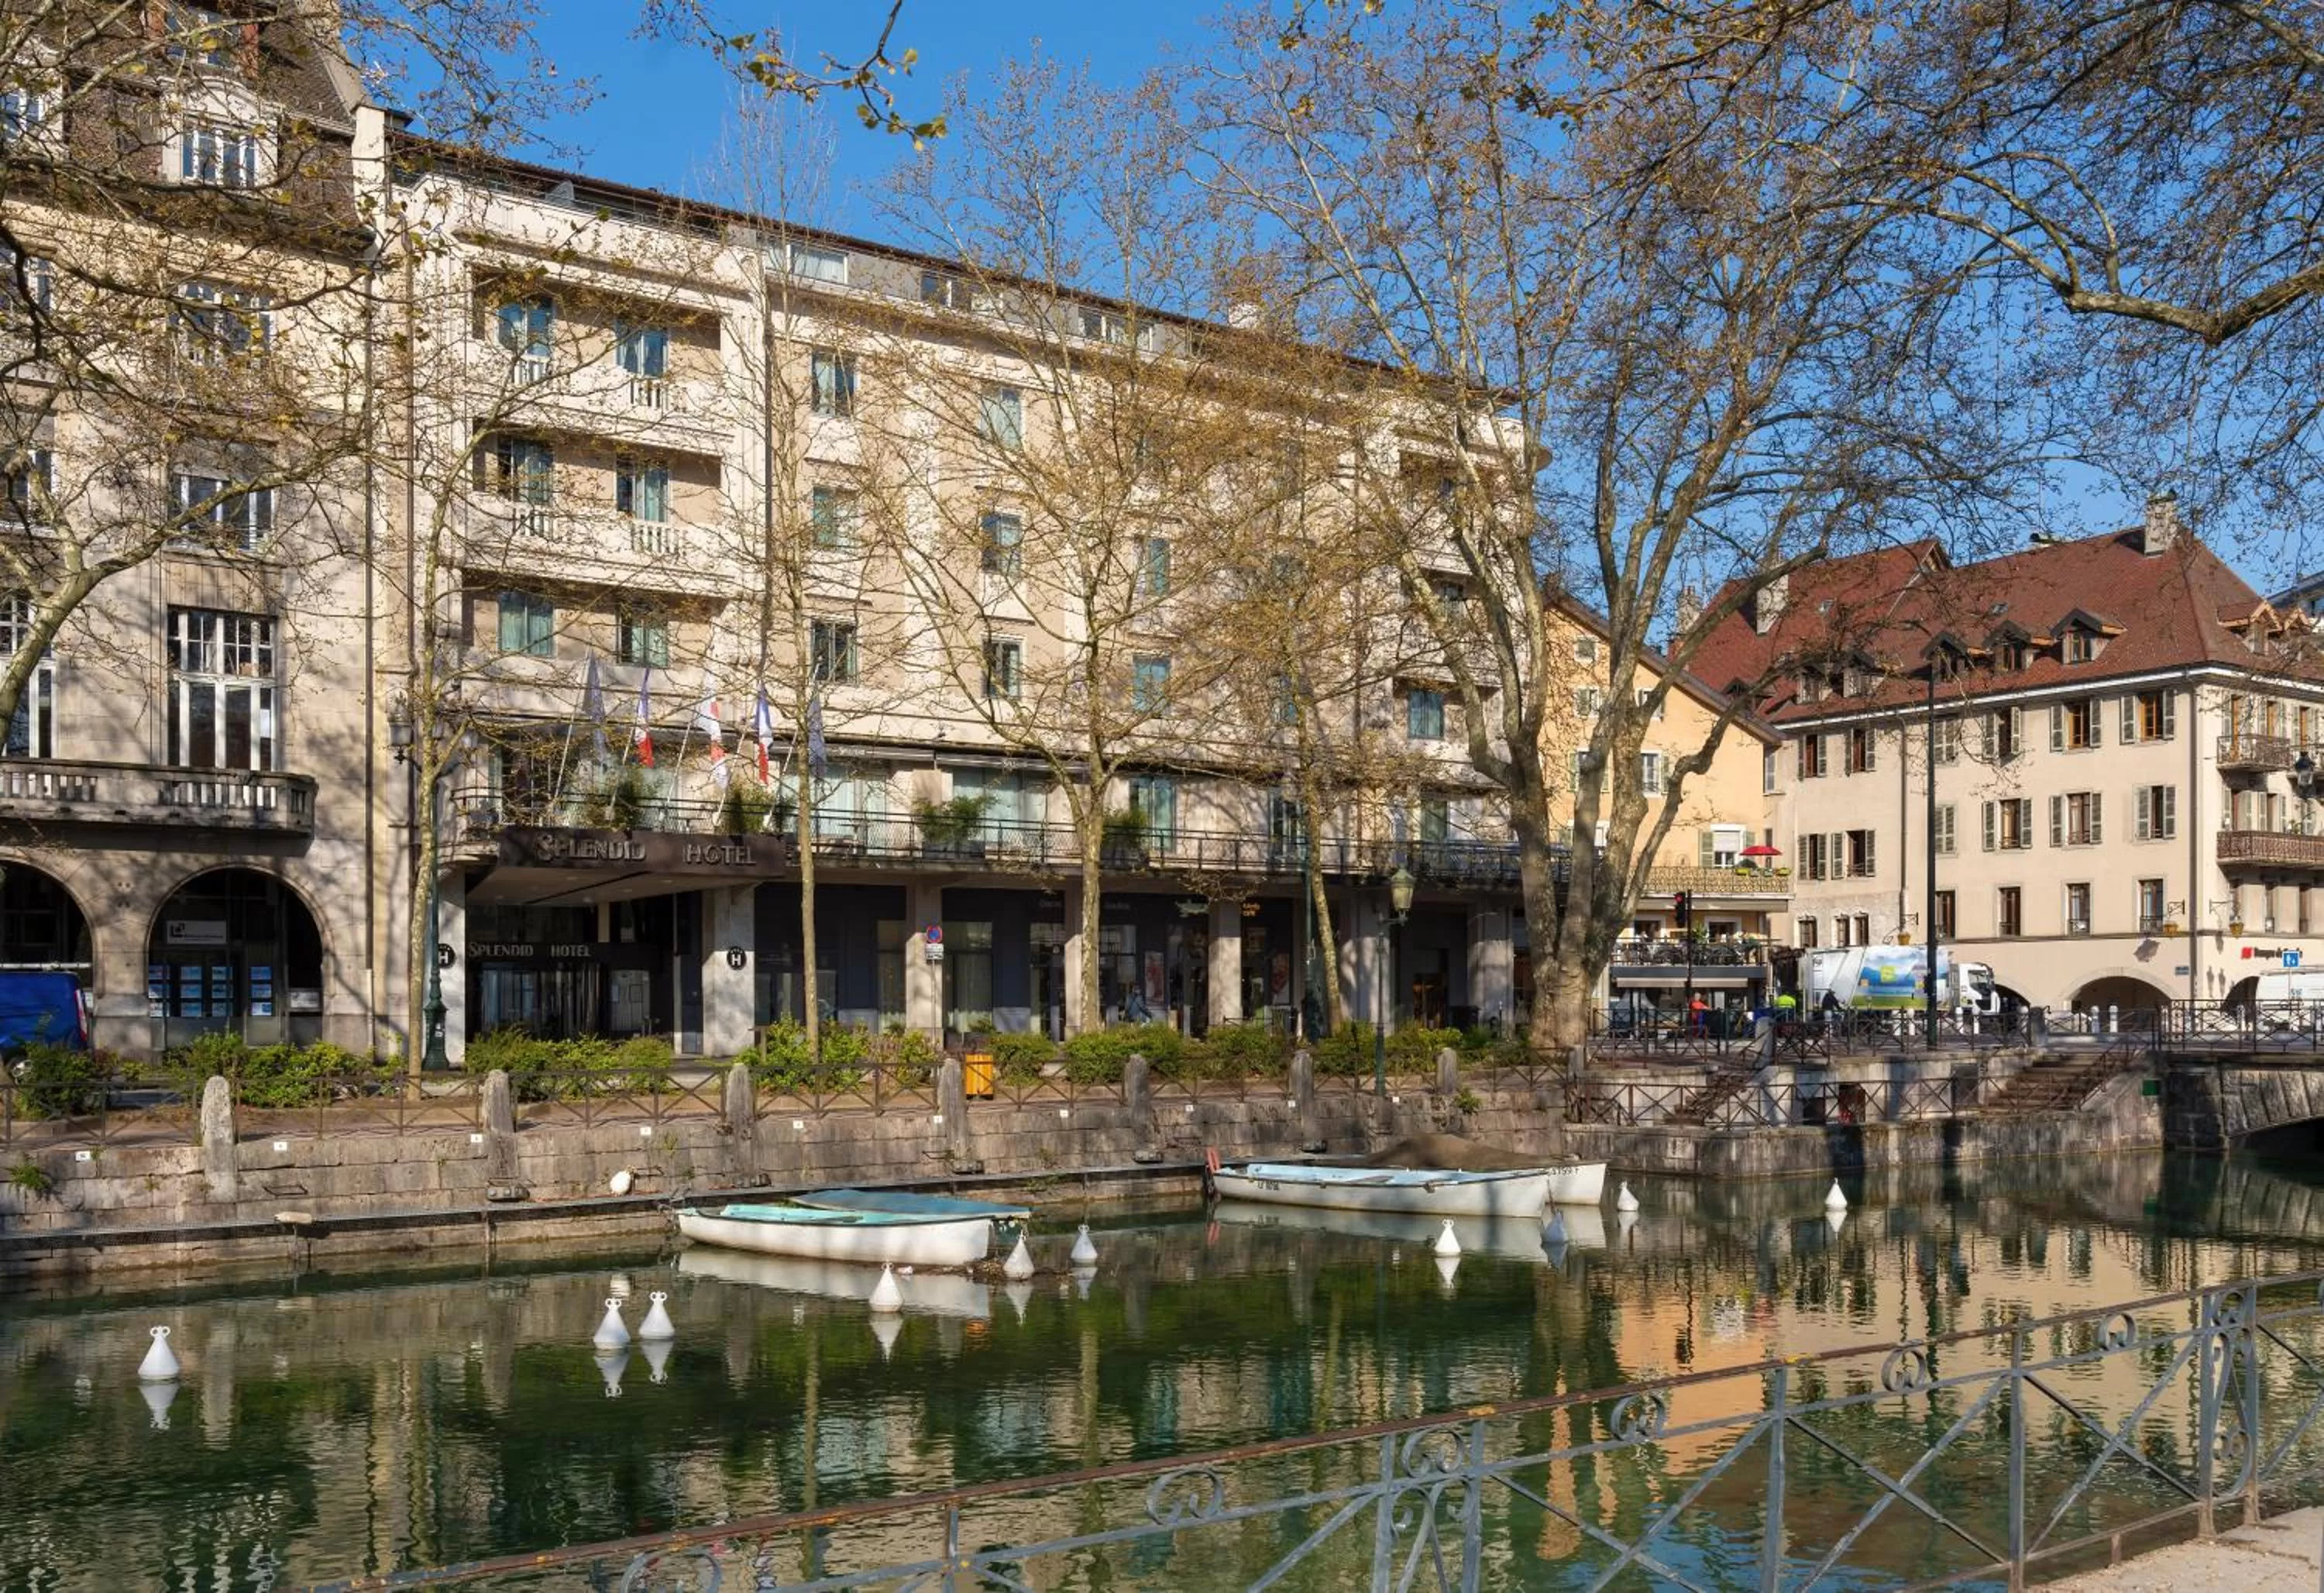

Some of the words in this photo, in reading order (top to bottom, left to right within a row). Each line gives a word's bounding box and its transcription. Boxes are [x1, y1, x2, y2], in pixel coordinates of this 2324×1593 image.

[535, 834, 646, 862] SPLENDID
[682, 843, 757, 865] HOTEL
[469, 942, 534, 957] SPLENDID
[551, 944, 591, 958] HOTEL
[438, 951, 449, 965] H
[731, 954, 741, 966] H
